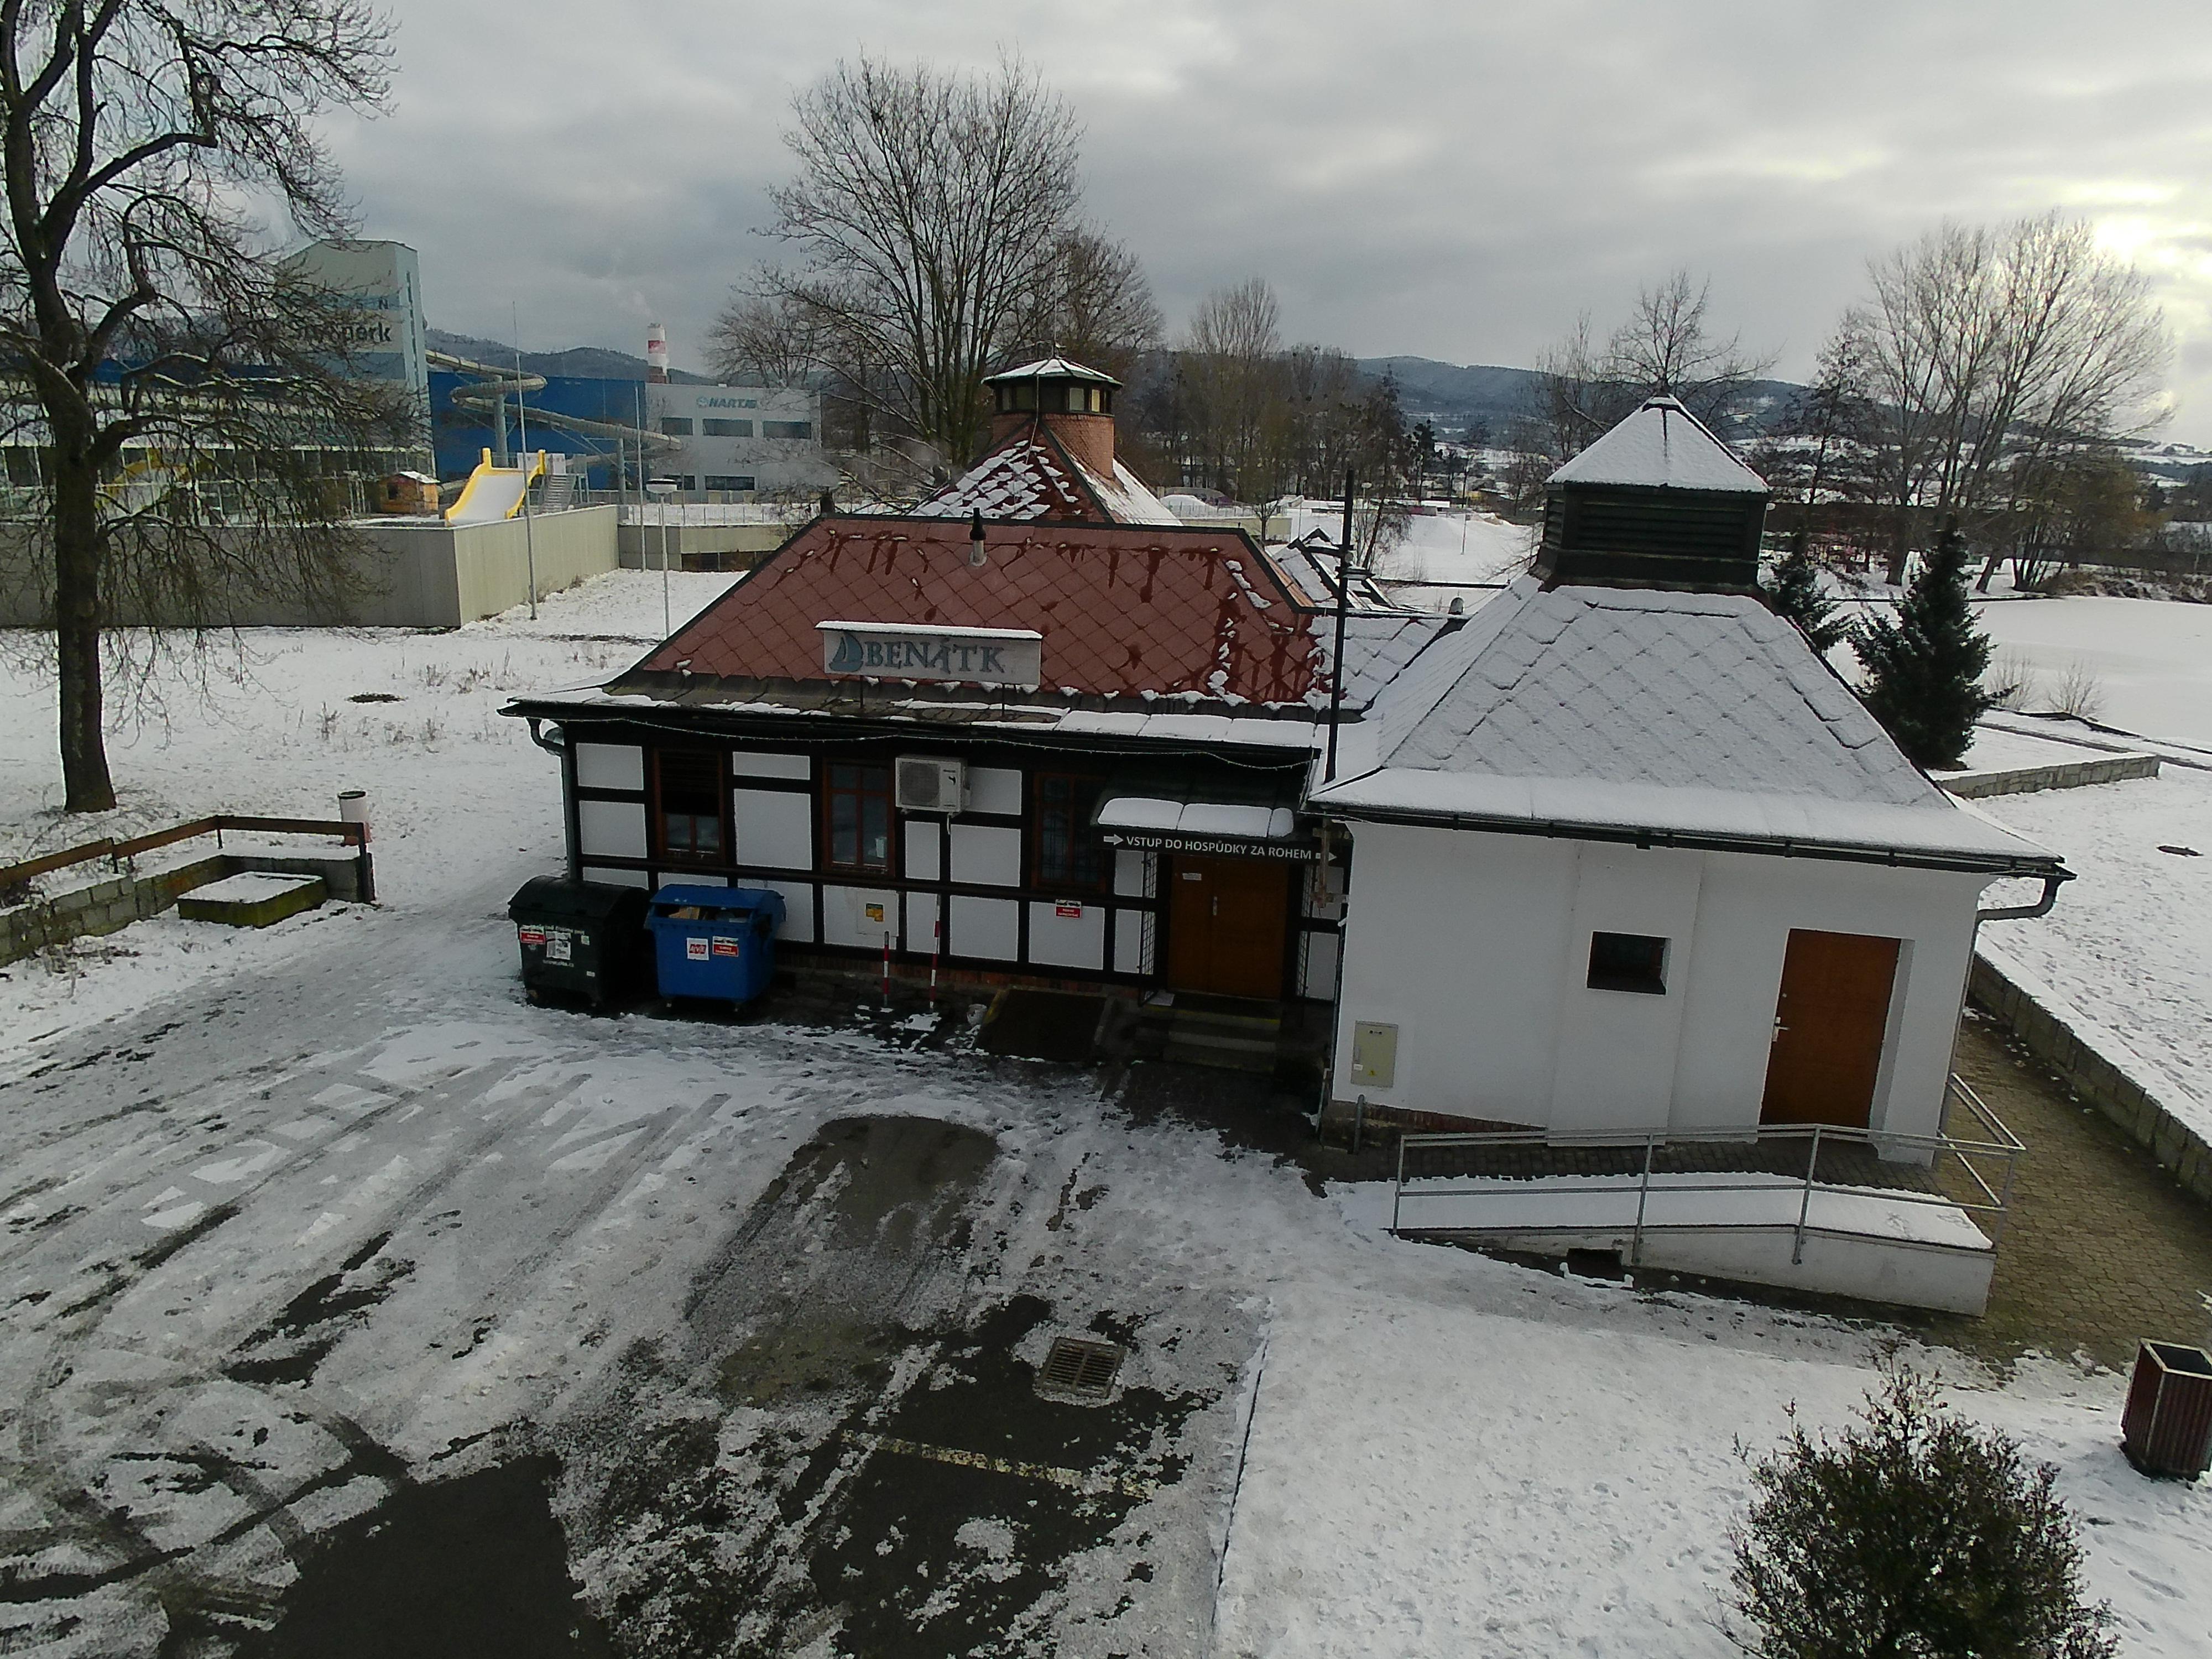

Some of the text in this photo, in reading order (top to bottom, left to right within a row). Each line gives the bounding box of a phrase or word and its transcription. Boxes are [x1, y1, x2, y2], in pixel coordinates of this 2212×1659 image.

[1126, 836, 1311, 859] VSTUP DO HOSPŮDKY ZA ROHEM
